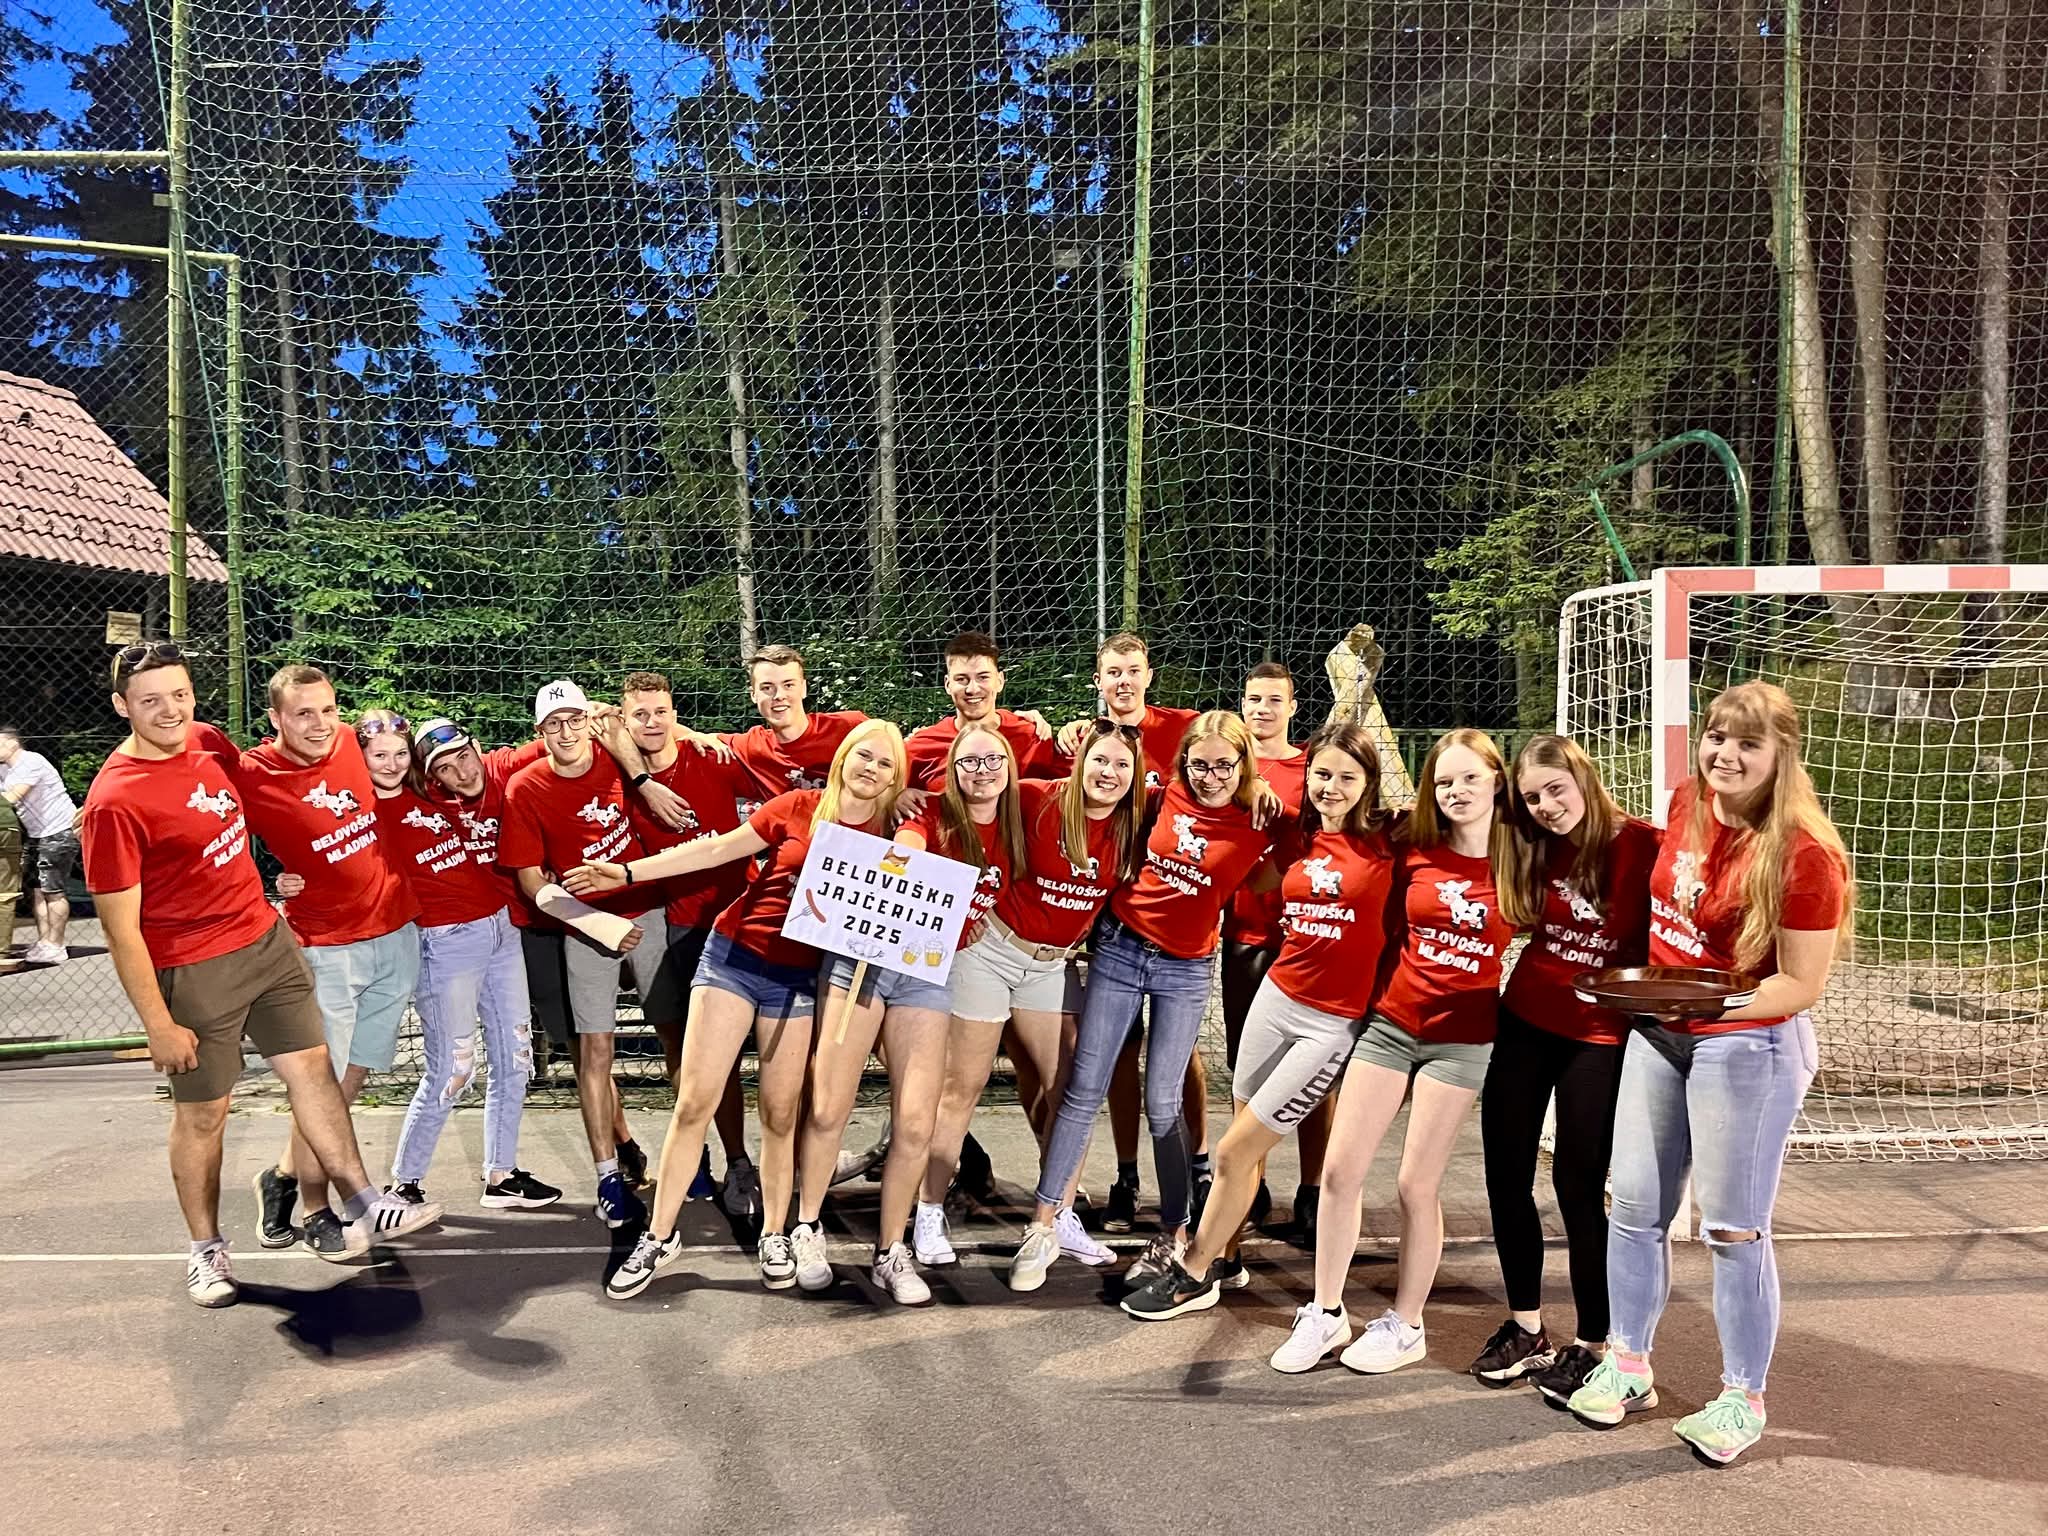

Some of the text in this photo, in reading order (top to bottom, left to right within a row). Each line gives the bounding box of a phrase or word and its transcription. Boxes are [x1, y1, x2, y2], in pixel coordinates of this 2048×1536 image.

[311, 811, 378, 852] BELOVOŠKA
[326, 830, 378, 864] MLADINA
[821, 856, 955, 909] BELOVOŠKA
[1036, 876, 1108, 897] BELOVOŠKA
[817, 881, 944, 932] JAJČERIJA
[1041, 892, 1094, 911] MLADINA
[843, 915, 902, 945] 2025
